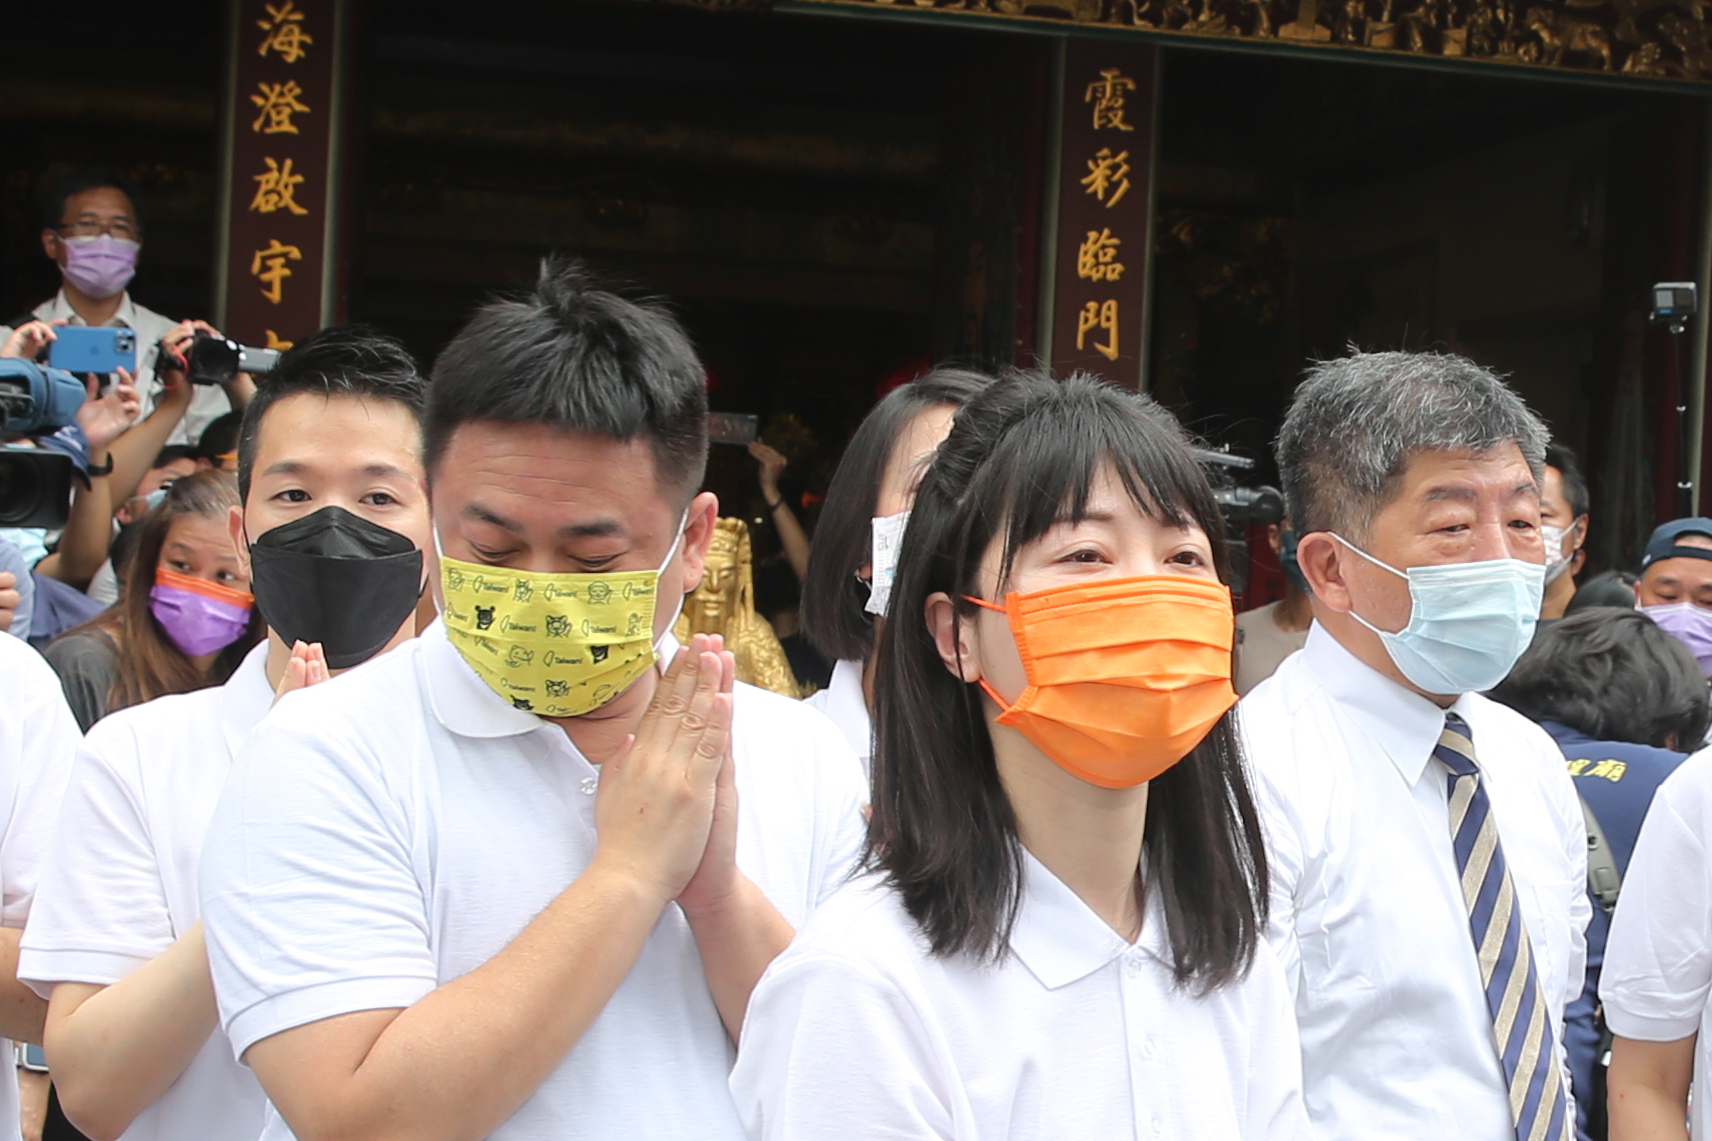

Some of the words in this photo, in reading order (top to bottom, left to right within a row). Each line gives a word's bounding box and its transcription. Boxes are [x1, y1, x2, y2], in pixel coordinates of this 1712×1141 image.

[249, 0, 314, 352] 海澄啟宇
[1076, 67, 1137, 361] 霞彩臨門
